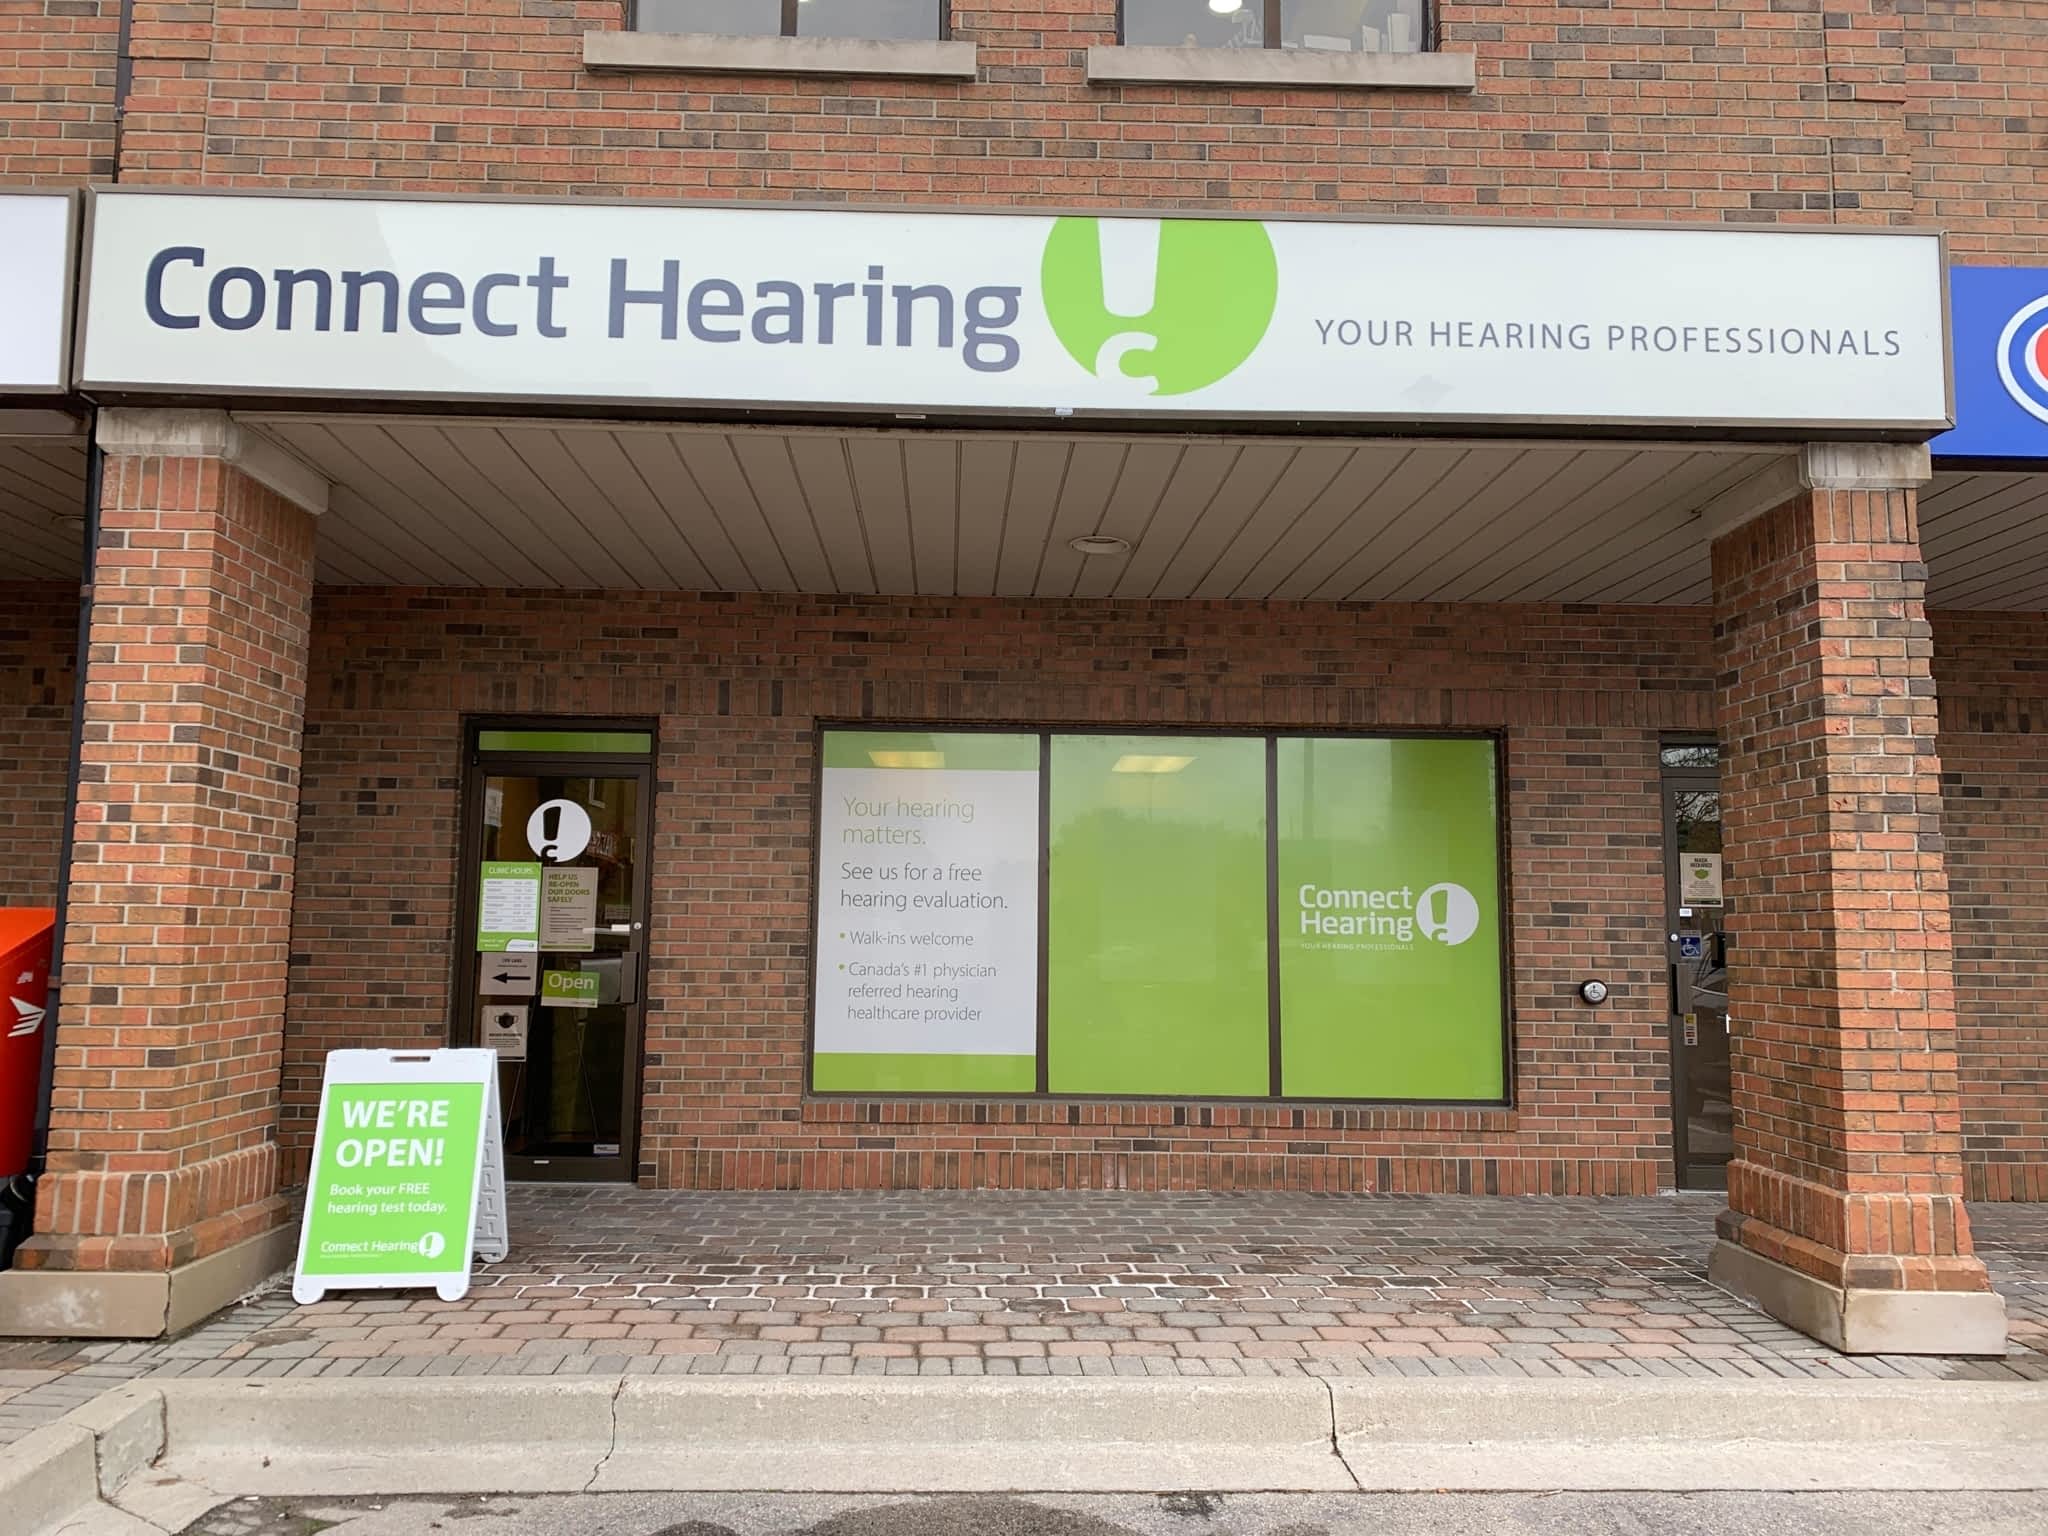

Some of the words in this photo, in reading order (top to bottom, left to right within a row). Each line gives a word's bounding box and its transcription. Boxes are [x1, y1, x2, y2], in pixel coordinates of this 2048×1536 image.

[145, 245, 569, 338] Connect
[607, 258, 1021, 372] Hearing
[1315, 319, 1414, 347] YOUR
[1430, 321, 1591, 350] HEARING
[1608, 325, 1902, 357] PROFESSIONALS
[843, 795, 889, 818] Your
[897, 797, 975, 824] hearing
[842, 825, 927, 845] matters.
[548, 873, 567, 881] HELP
[841, 862, 873, 880] See
[879, 866, 898, 881] us
[904, 863, 928, 881] for
[932, 867, 943, 881] a
[948, 863, 983, 882] free
[548, 888, 564, 896] OUR
[565, 888, 590, 896] DOORS
[840, 890, 907, 912] hearing
[912, 892, 1009, 910] evaluation.
[1299, 884, 1414, 910] Connect
[1301, 911, 1414, 942] Hearing
[849, 931, 906, 946] Walk-ins
[910, 932, 974, 947] welcome
[848, 962, 910, 977] Canada's
[914, 963, 928, 977] #1
[933, 962, 997, 981] physician
[548, 973, 594, 992] Open
[848, 984, 902, 998] referred
[906, 984, 959, 1002] hearing
[847, 1006, 920, 1021] healthcare
[924, 1006, 982, 1025] provider
[341, 1100, 450, 1129] WE'RE
[335, 1138, 445, 1168] OPEN!
[330, 1184, 363, 1196] Book
[366, 1185, 396, 1198] your
[399, 1182, 430, 1195] FREE
[328, 1201, 377, 1216] hearing
[380, 1202, 405, 1213] test
[408, 1201, 448, 1215] today.
[320, 1240, 369, 1253] Connect
[371, 1239, 418, 1254] Hearing
